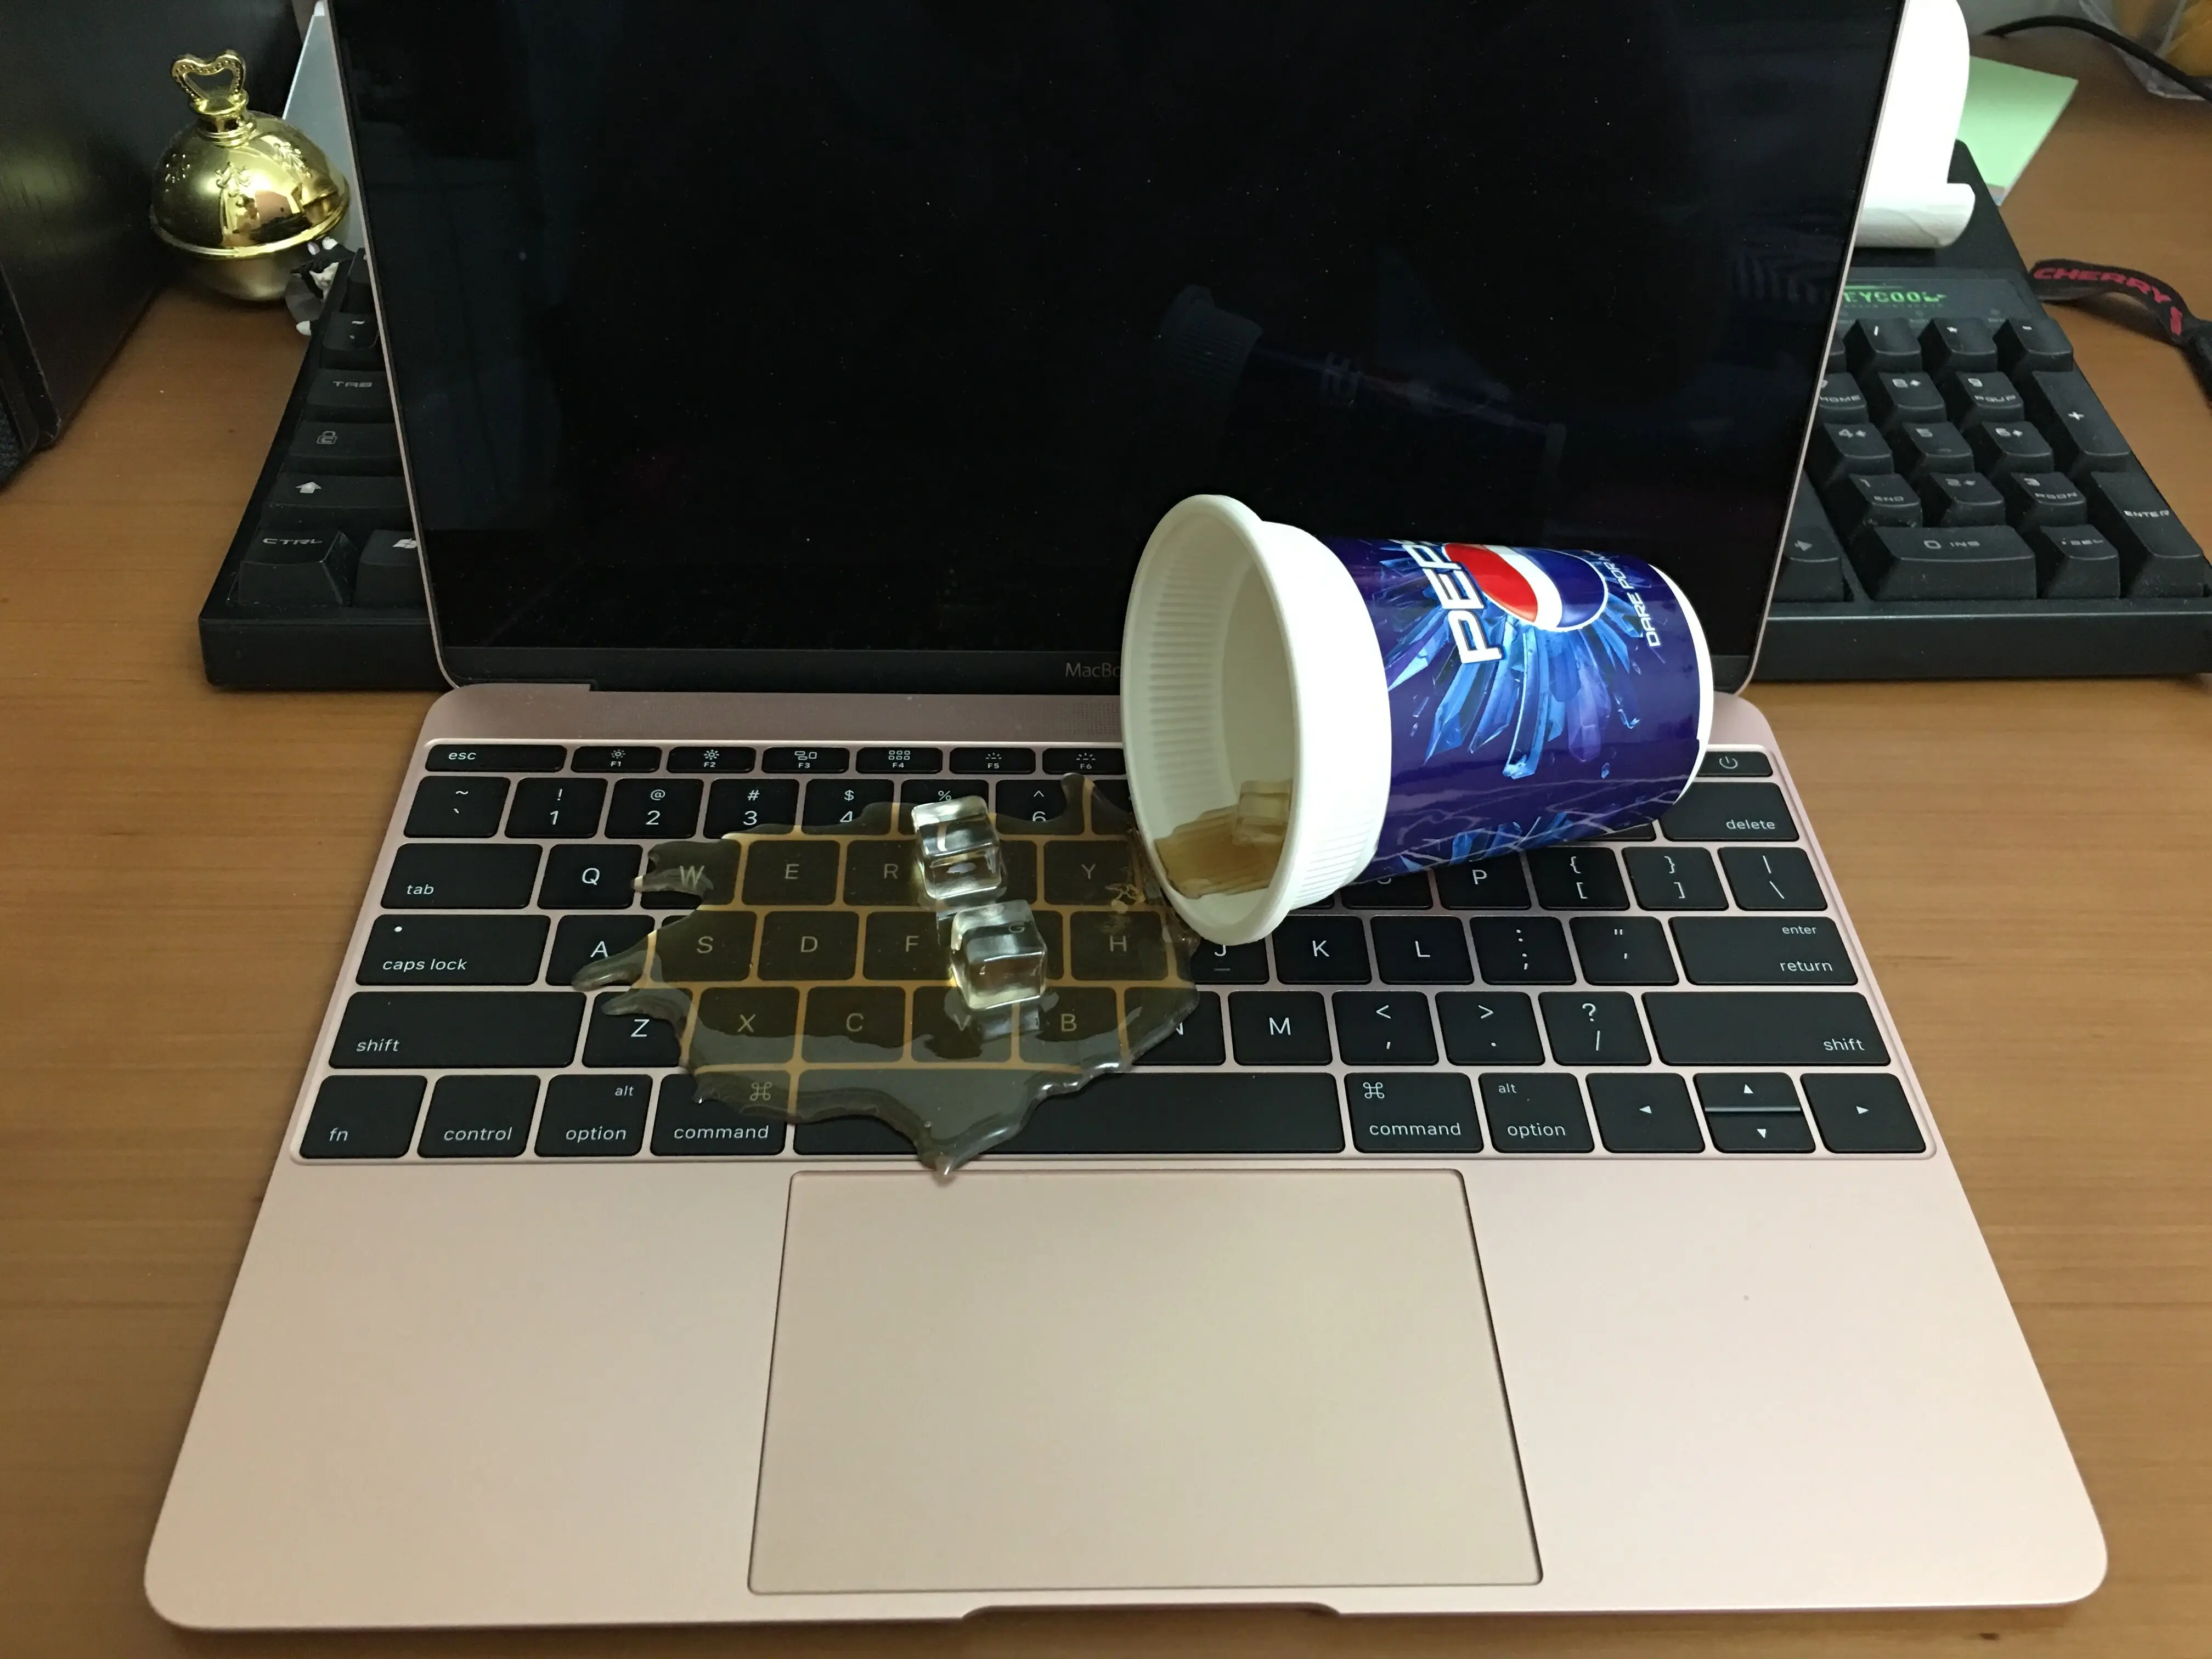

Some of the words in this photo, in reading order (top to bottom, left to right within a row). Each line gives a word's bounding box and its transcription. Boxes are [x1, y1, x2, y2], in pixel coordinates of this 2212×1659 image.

[2033, 268, 2171, 303] CHERRY
[1844, 291, 1945, 302] EYCOOL
[1390, 539, 1503, 664] PEP
[1627, 592, 1661, 647] DARE
[448, 752, 477, 760] esc
[557, 788, 563, 801] !
[650, 789, 665, 801] @
[747, 789, 760, 801] #
[844, 789, 854, 802] $
[550, 810, 558, 825] 1
[646, 810, 661, 825] 2
[743, 810, 757, 826] 3
[839, 811, 853, 823] 4
[1032, 811, 1046, 822] 6
[1726, 819, 1775, 830] delete
[582, 867, 600, 885] Q
[679, 865, 705, 888] W
[785, 864, 799, 879] E
[884, 864, 899, 879] R
[1081, 864, 1096, 879] Y
[1472, 870, 1487, 885] P
[407, 884, 434, 895] tab
[1782, 926, 1816, 934] enter
[590, 940, 608, 958] A
[696, 935, 714, 953] S
[800, 936, 818, 952] D
[905, 935, 919, 952] F
[1109, 935, 1127, 952] H
[1214, 944, 1227, 957] J
[1312, 940, 1330, 957] K
[1415, 940, 1431, 957] L
[382, 961, 425, 973] caps
[430, 958, 467, 970] lock
[1780, 961, 1833, 972] return
[1582, 1003, 1596, 1022] ?
[630, 1019, 650, 1037] Z
[737, 1014, 756, 1032] X
[846, 1013, 864, 1032] C
[1061, 1013, 1077, 1032] B
[1269, 1017, 1291, 1035] M
[356, 1038, 400, 1052] shift
[1823, 1038, 1865, 1051] shift
[614, 1085, 634, 1096] alt
[1498, 1083, 1517, 1093] alt
[329, 1127, 348, 1142] fn
[444, 1127, 512, 1141] control
[566, 1126, 626, 1143] option
[674, 1125, 769, 1139] command
[1369, 1122, 1461, 1136] command
[1507, 1122, 1566, 1139] option
